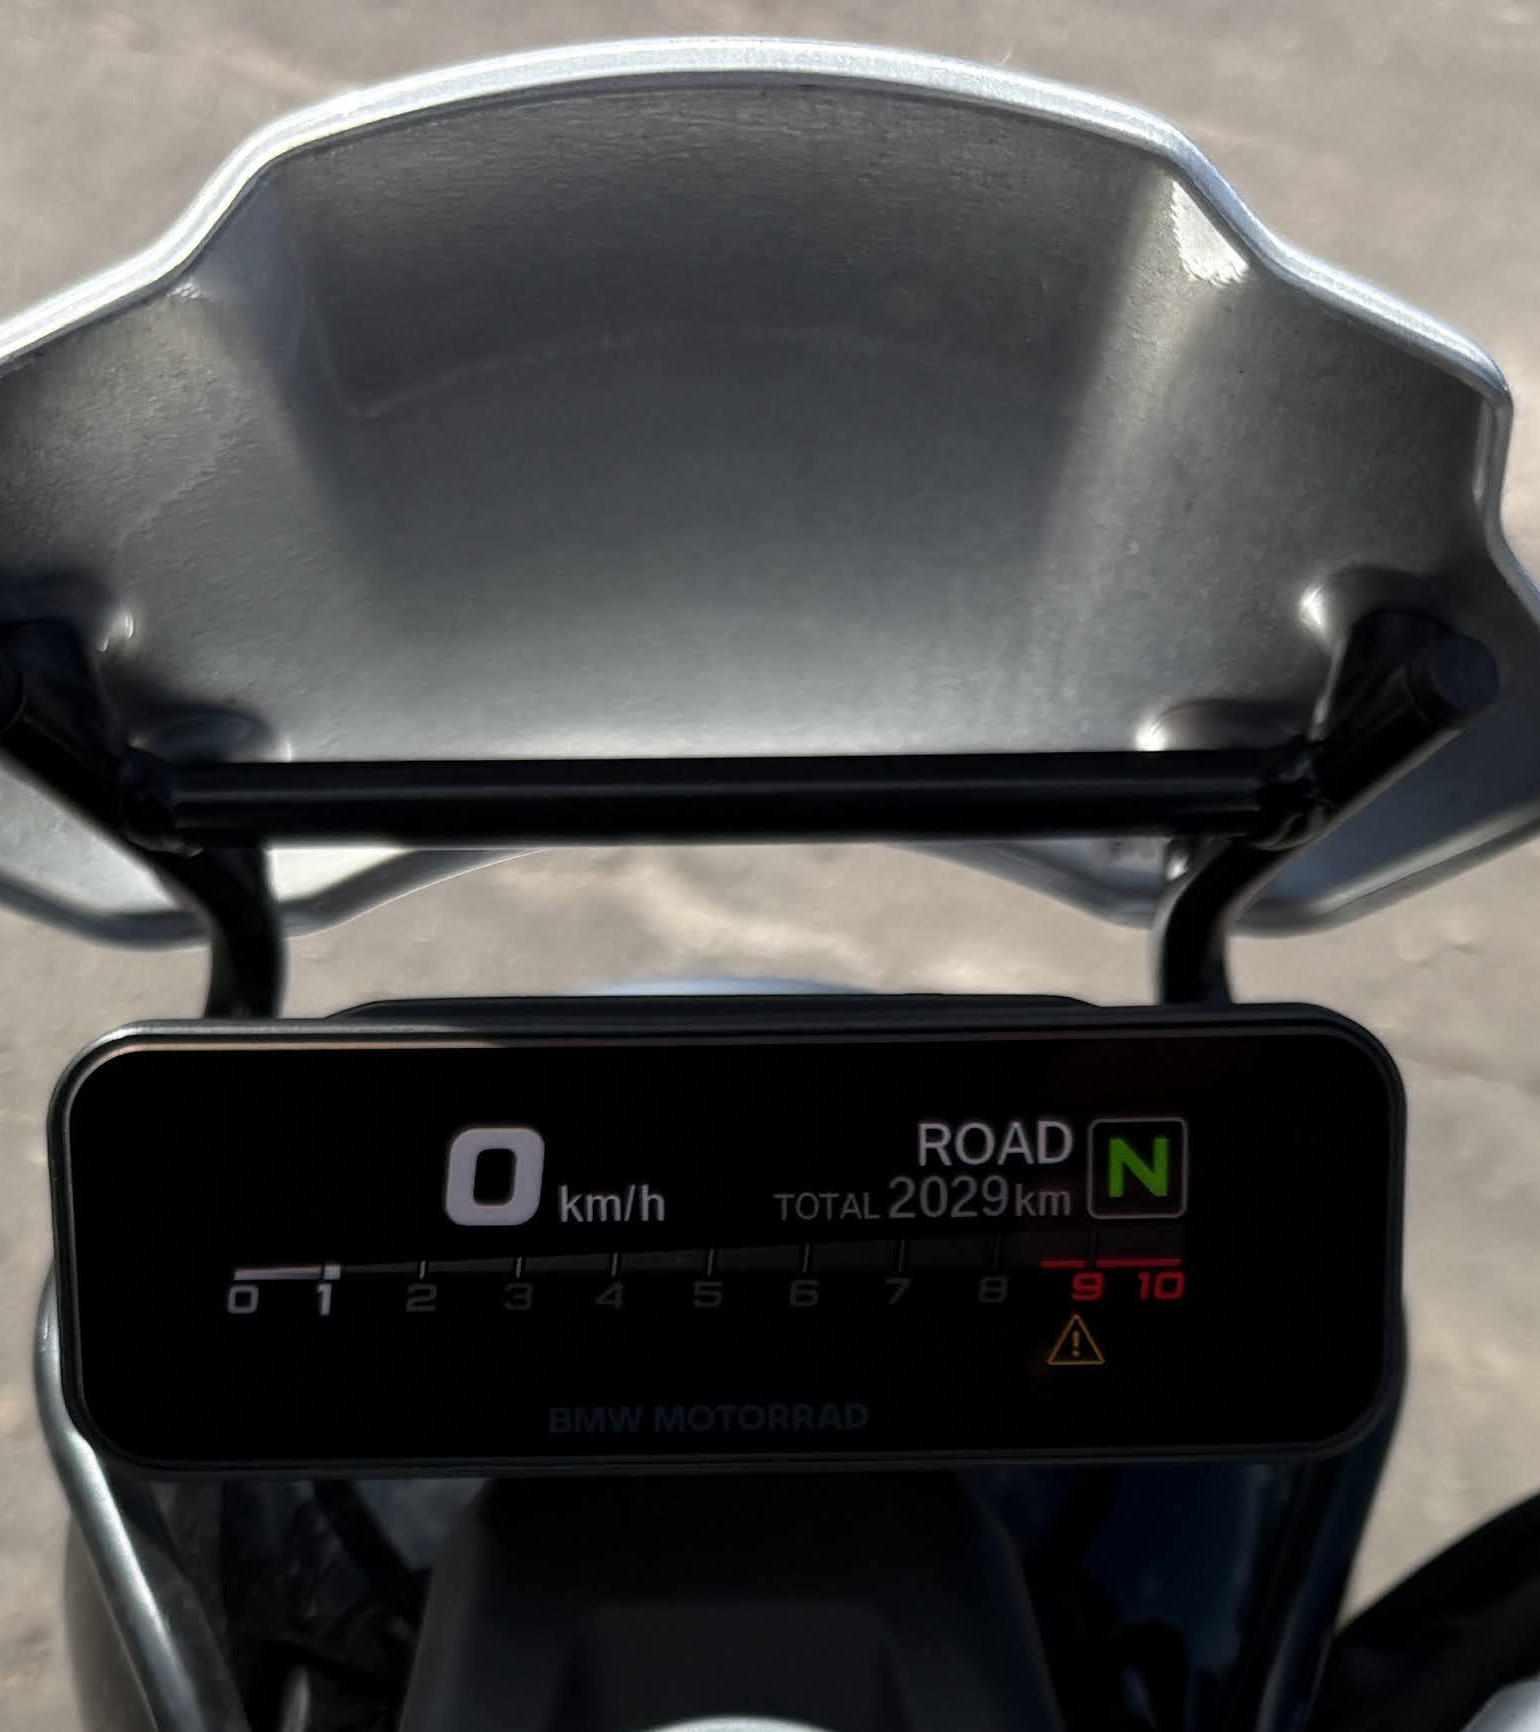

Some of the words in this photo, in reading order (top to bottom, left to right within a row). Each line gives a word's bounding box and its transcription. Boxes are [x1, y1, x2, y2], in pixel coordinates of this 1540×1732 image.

[917, 1120, 1075, 1167] ROAD
[1108, 1137, 1168, 1197] N
[443, 1124, 546, 1227] 0
[559, 1180, 668, 1223] km/h
[773, 1191, 880, 1221] TOTAL
[887, 1174, 1010, 1219] 2029
[1015, 1182, 1073, 1217] km
[225, 1284, 261, 1315] 0
[314, 1282, 333, 1317] 1
[404, 1284, 438, 1313] 2
[502, 1281, 534, 1311] 3
[593, 1281, 627, 1311] 4
[692, 1280, 725, 1310] 5
[788, 1279, 821, 1309] 6
[884, 1277, 914, 1304] 7
[977, 1274, 1011, 1304] 8
[1069, 1271, 1106, 1302] 9
[1136, 1270, 1184, 1300] 10
[548, 1403, 645, 1433] BMW
[653, 1401, 869, 1433] MOTORRAD
